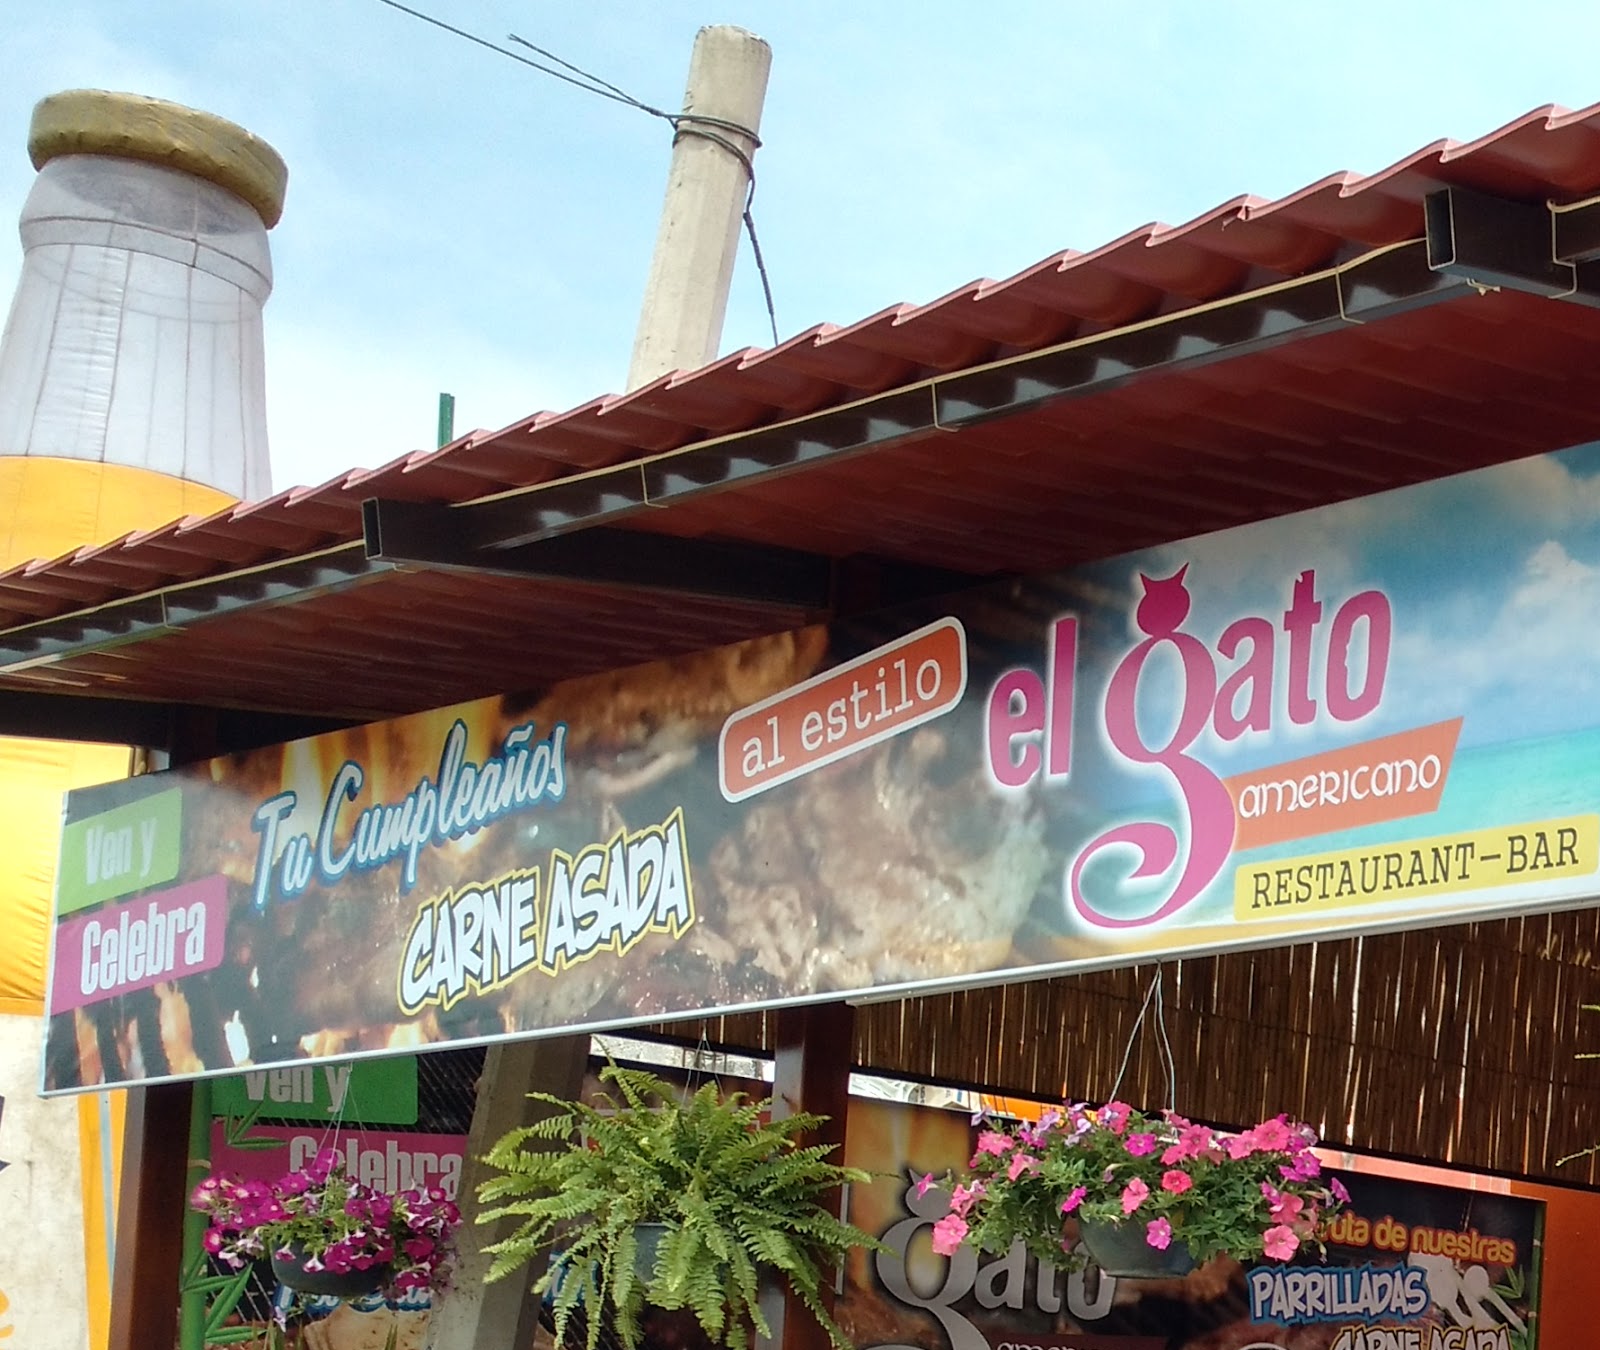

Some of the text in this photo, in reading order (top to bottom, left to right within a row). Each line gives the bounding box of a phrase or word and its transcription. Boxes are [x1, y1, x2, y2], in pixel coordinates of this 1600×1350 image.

[741, 653, 943, 779] al estilo
[988, 562, 1391, 928] el gato
[256, 720, 567, 907] Tu Cumpleaños
[1238, 750, 1442, 820] americano
[85, 817, 157, 886] Ven y
[1250, 825, 1581, 910] RESTAURANT-BAR
[80, 901, 207, 996] Celebra
[402, 820, 690, 1007] CARNE ASADA
[325, 1066, 349, 1112] y
[289, 1136, 463, 1201] Clebra
[1374, 1218, 1408, 1249] de
[1413, 1228, 1516, 1265] nuestras
[1251, 1268, 1425, 1321] PARRILLADAS
